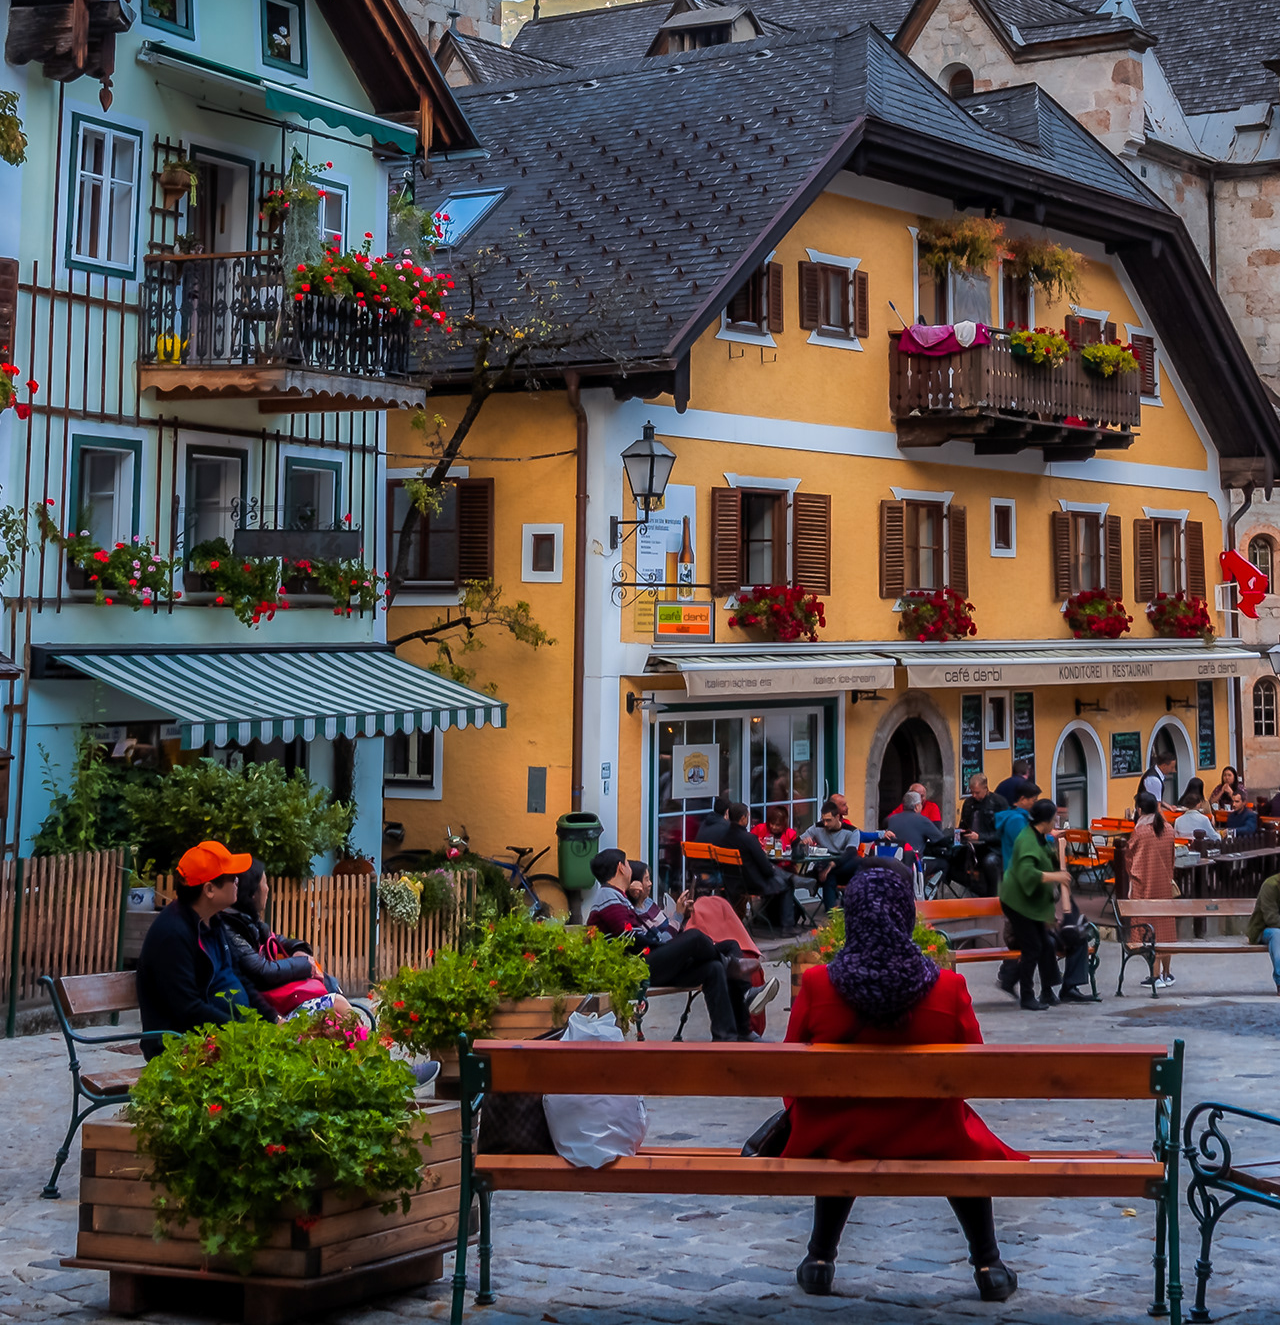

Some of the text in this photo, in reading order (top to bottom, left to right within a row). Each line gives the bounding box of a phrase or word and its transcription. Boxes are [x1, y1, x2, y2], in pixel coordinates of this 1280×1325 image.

[683, 612, 709, 622] derbl
[944, 666, 1003, 682] café derbl
[1058, 663, 1154, 679] KONDITOREI RESTAURANT
[1197, 660, 1238, 674] café derbl
